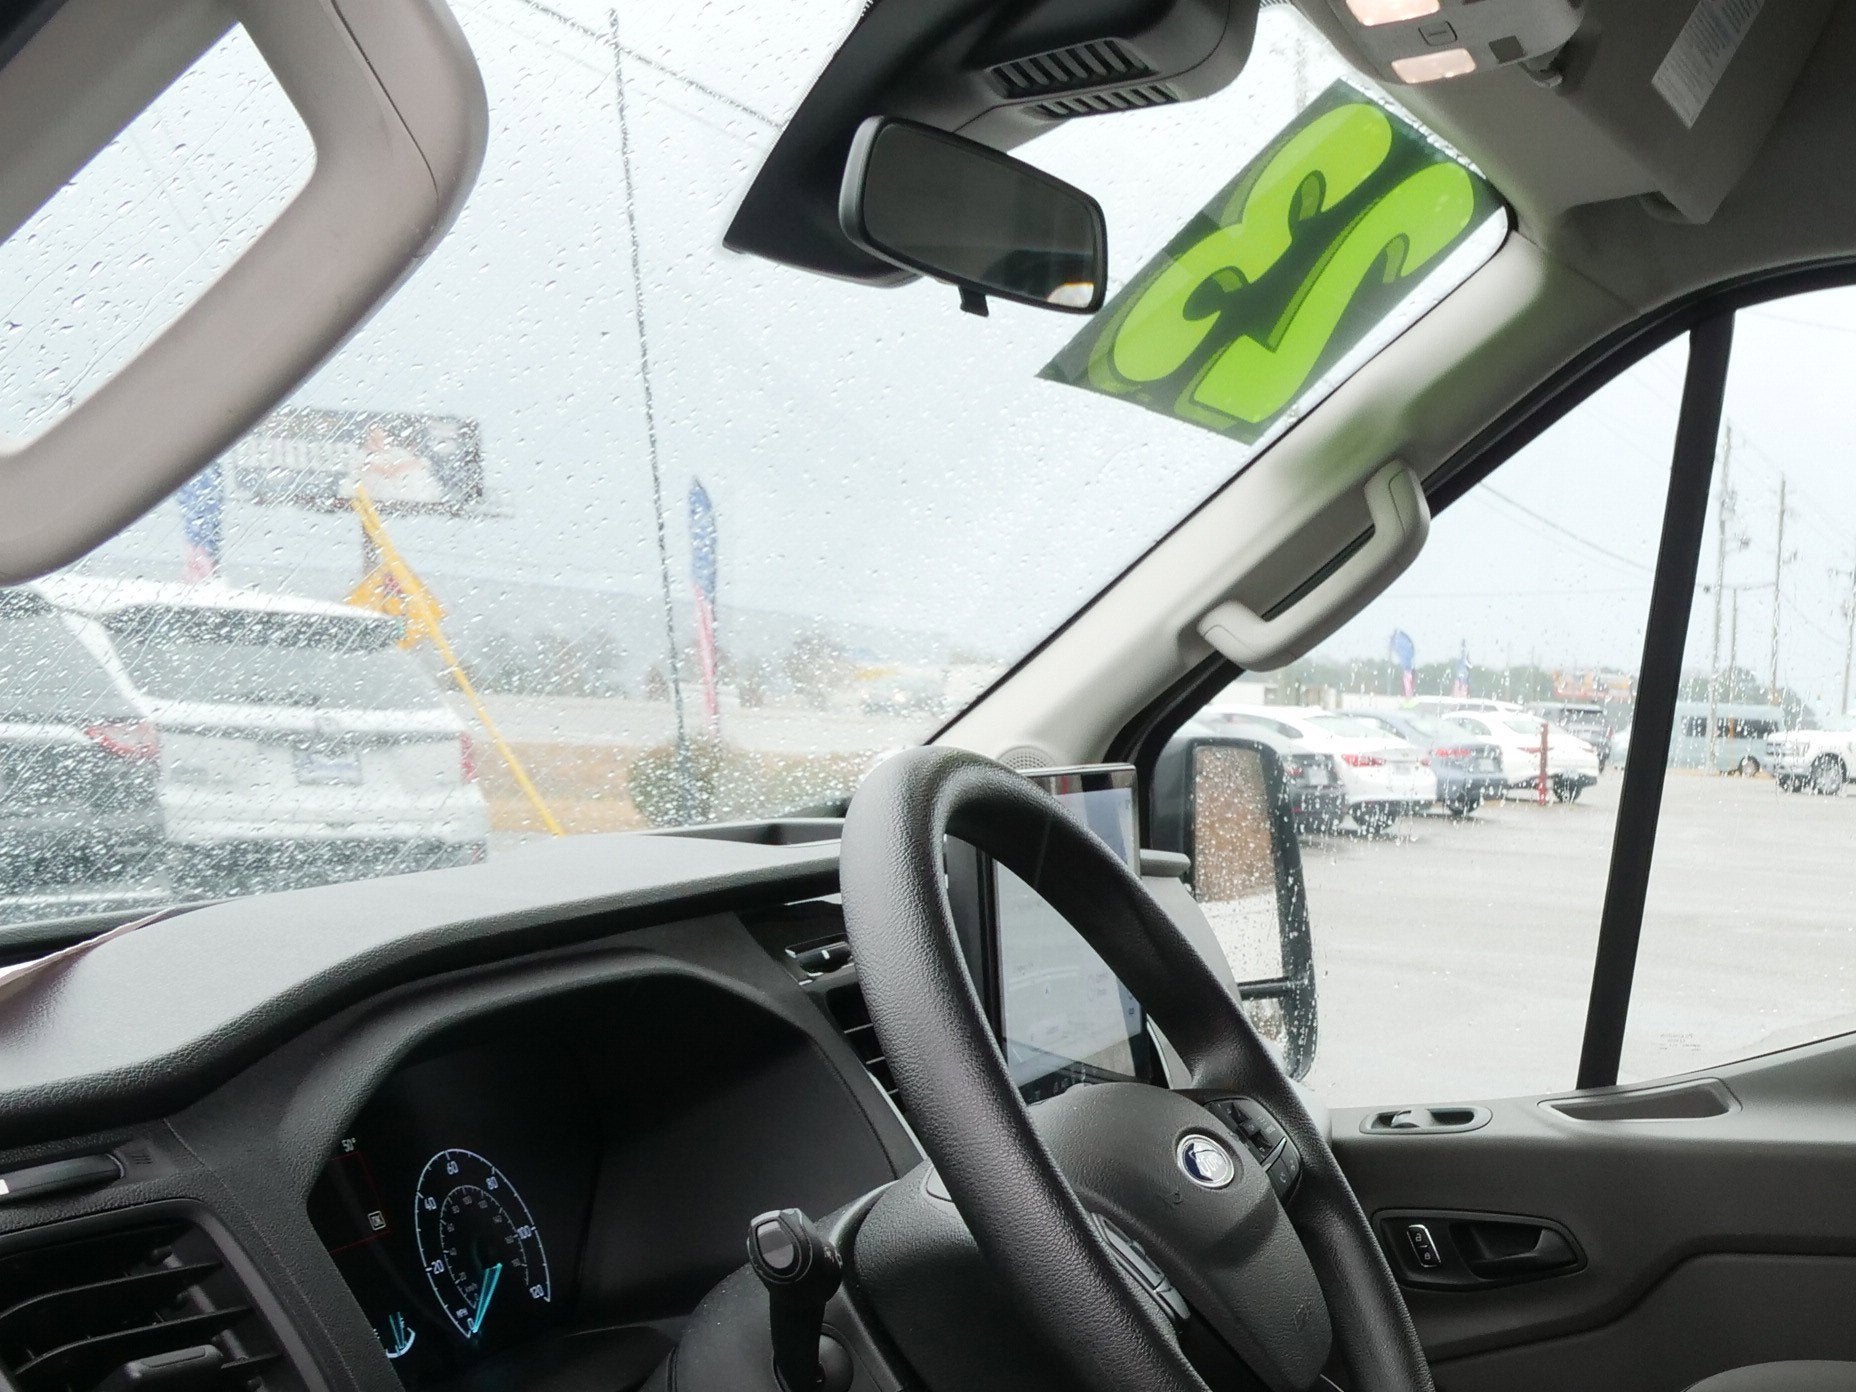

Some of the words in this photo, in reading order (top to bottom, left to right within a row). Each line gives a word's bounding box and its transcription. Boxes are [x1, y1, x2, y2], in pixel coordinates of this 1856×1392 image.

[446, 1160, 459, 1175] 60
[431, 1259, 445, 1275] 20
[529, 1284, 545, 1299] 120
